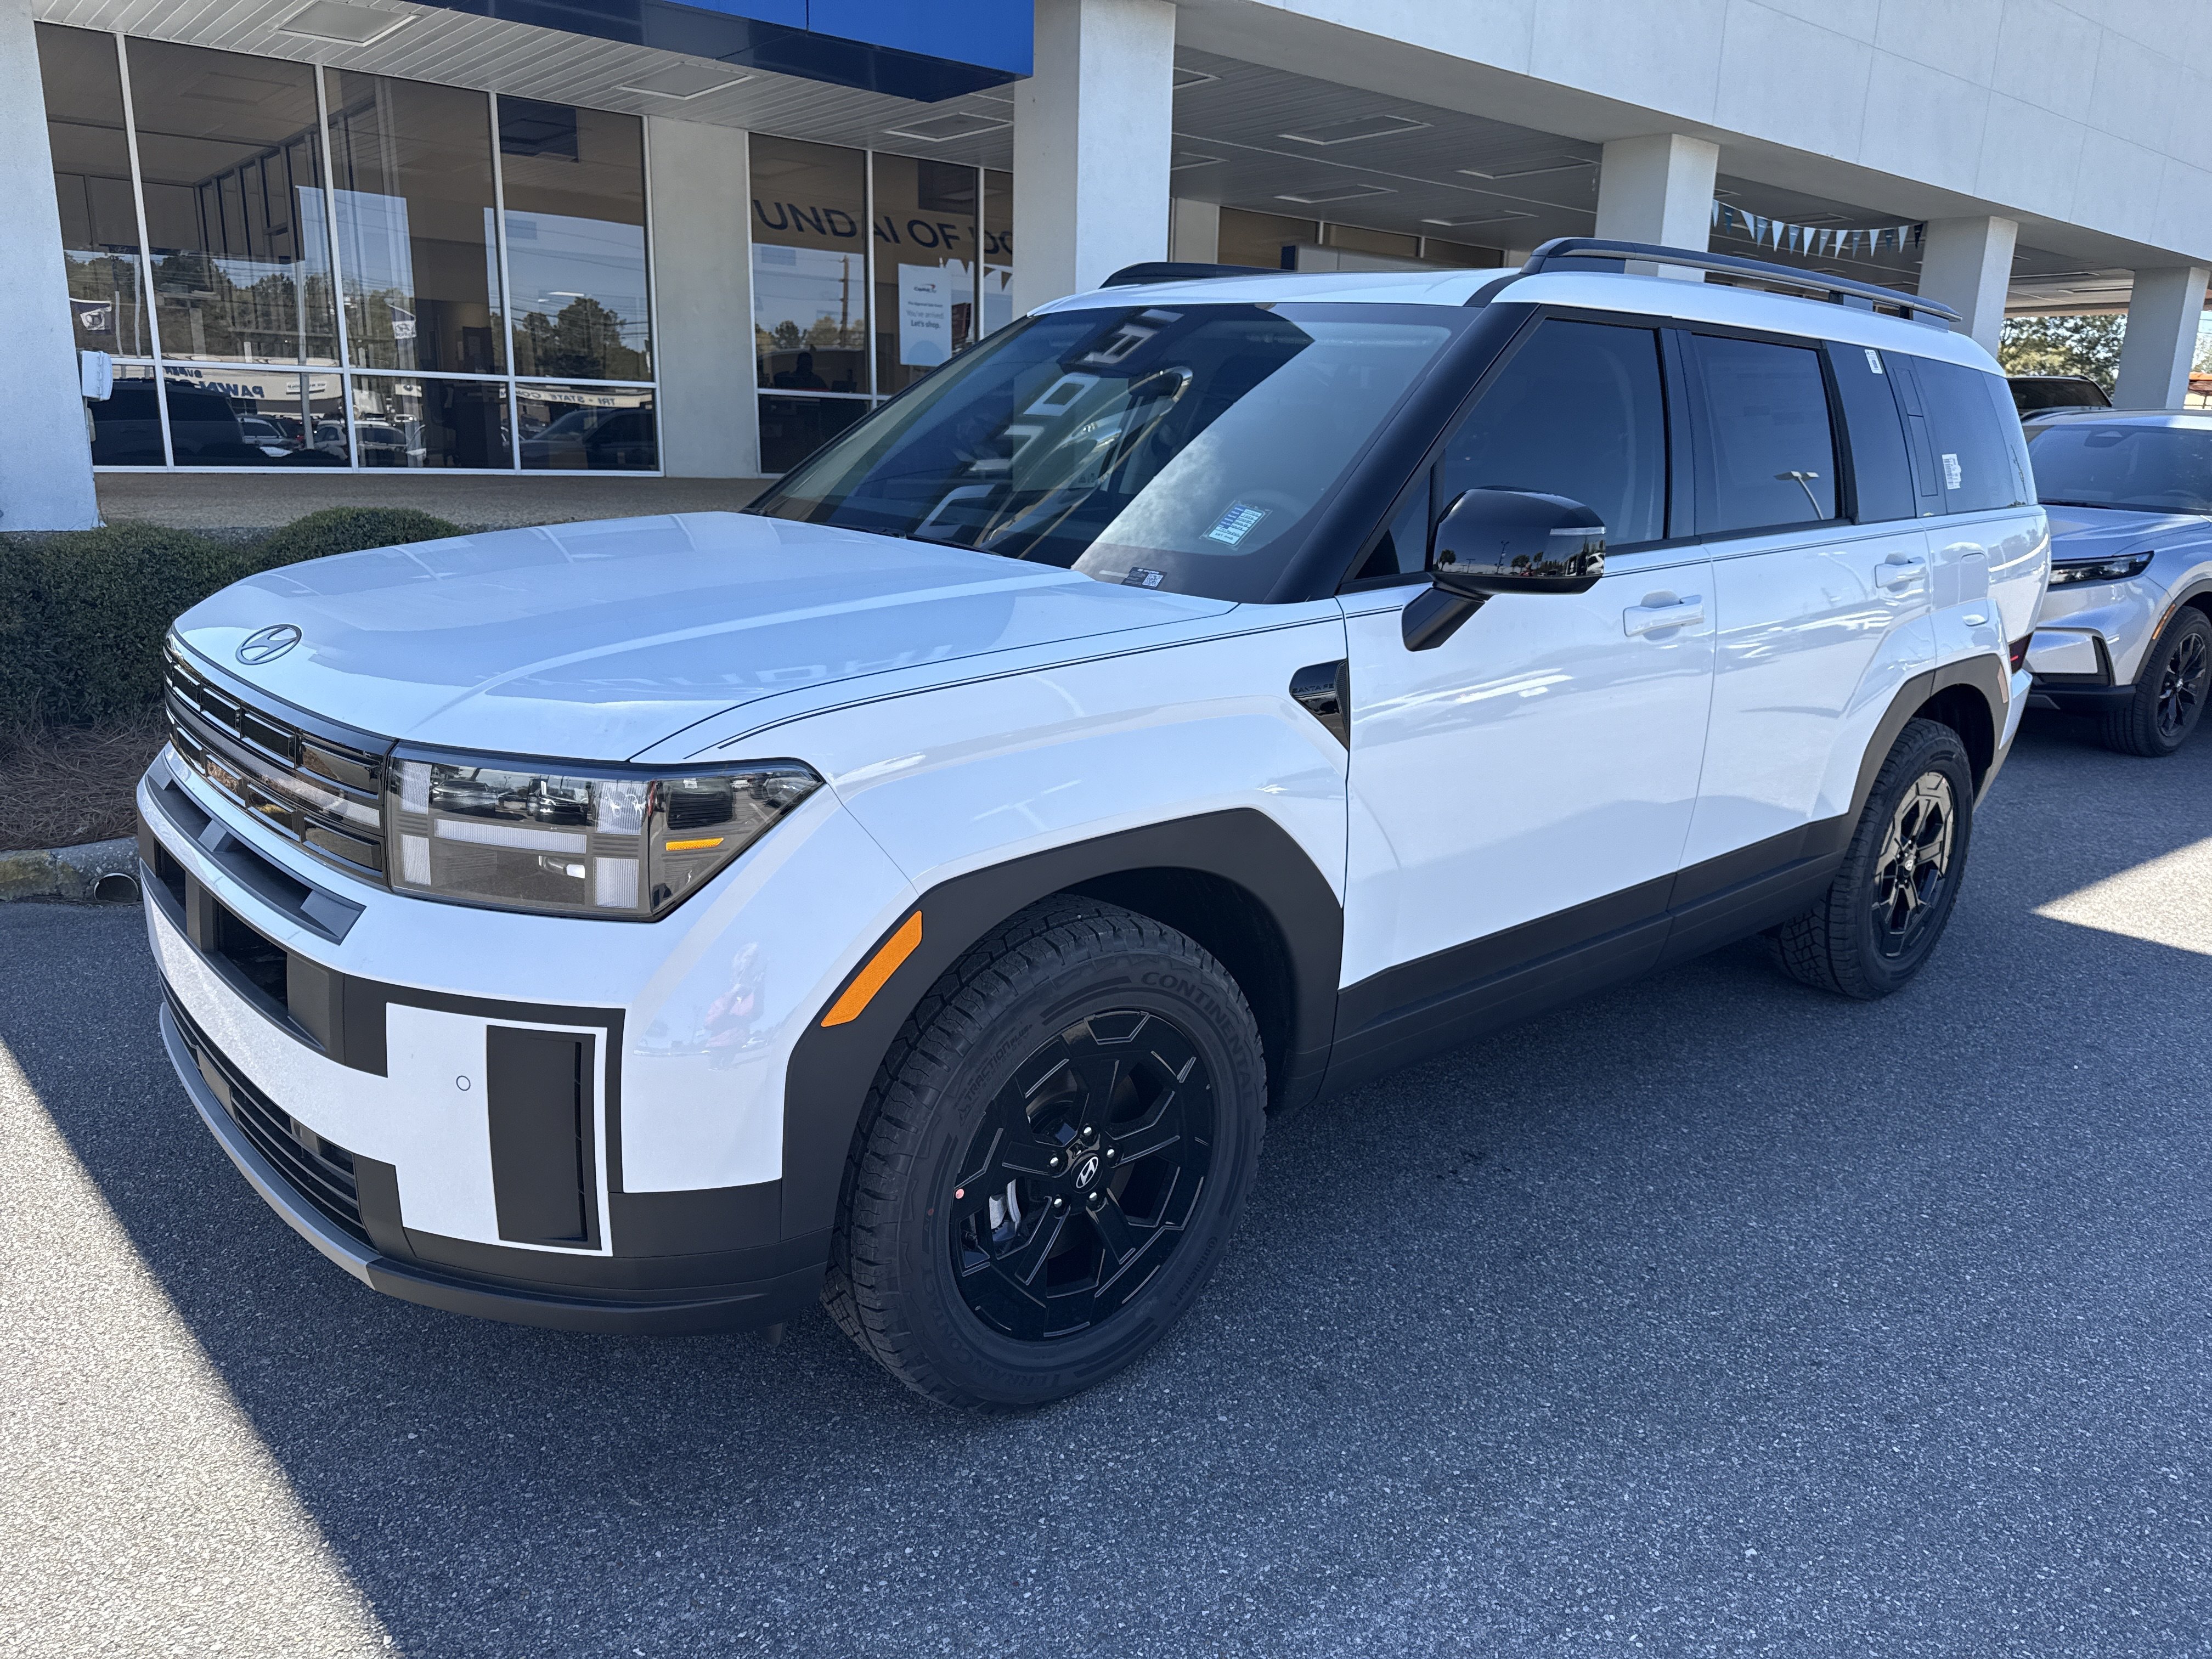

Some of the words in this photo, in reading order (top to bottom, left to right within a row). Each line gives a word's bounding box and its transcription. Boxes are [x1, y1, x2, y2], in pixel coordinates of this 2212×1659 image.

[906, 219, 961, 250] OF
[910, 320, 925, 328] Let's
[925, 320, 941, 329] shop.
[1140, 971, 1253, 1103] CONTINENTAL
